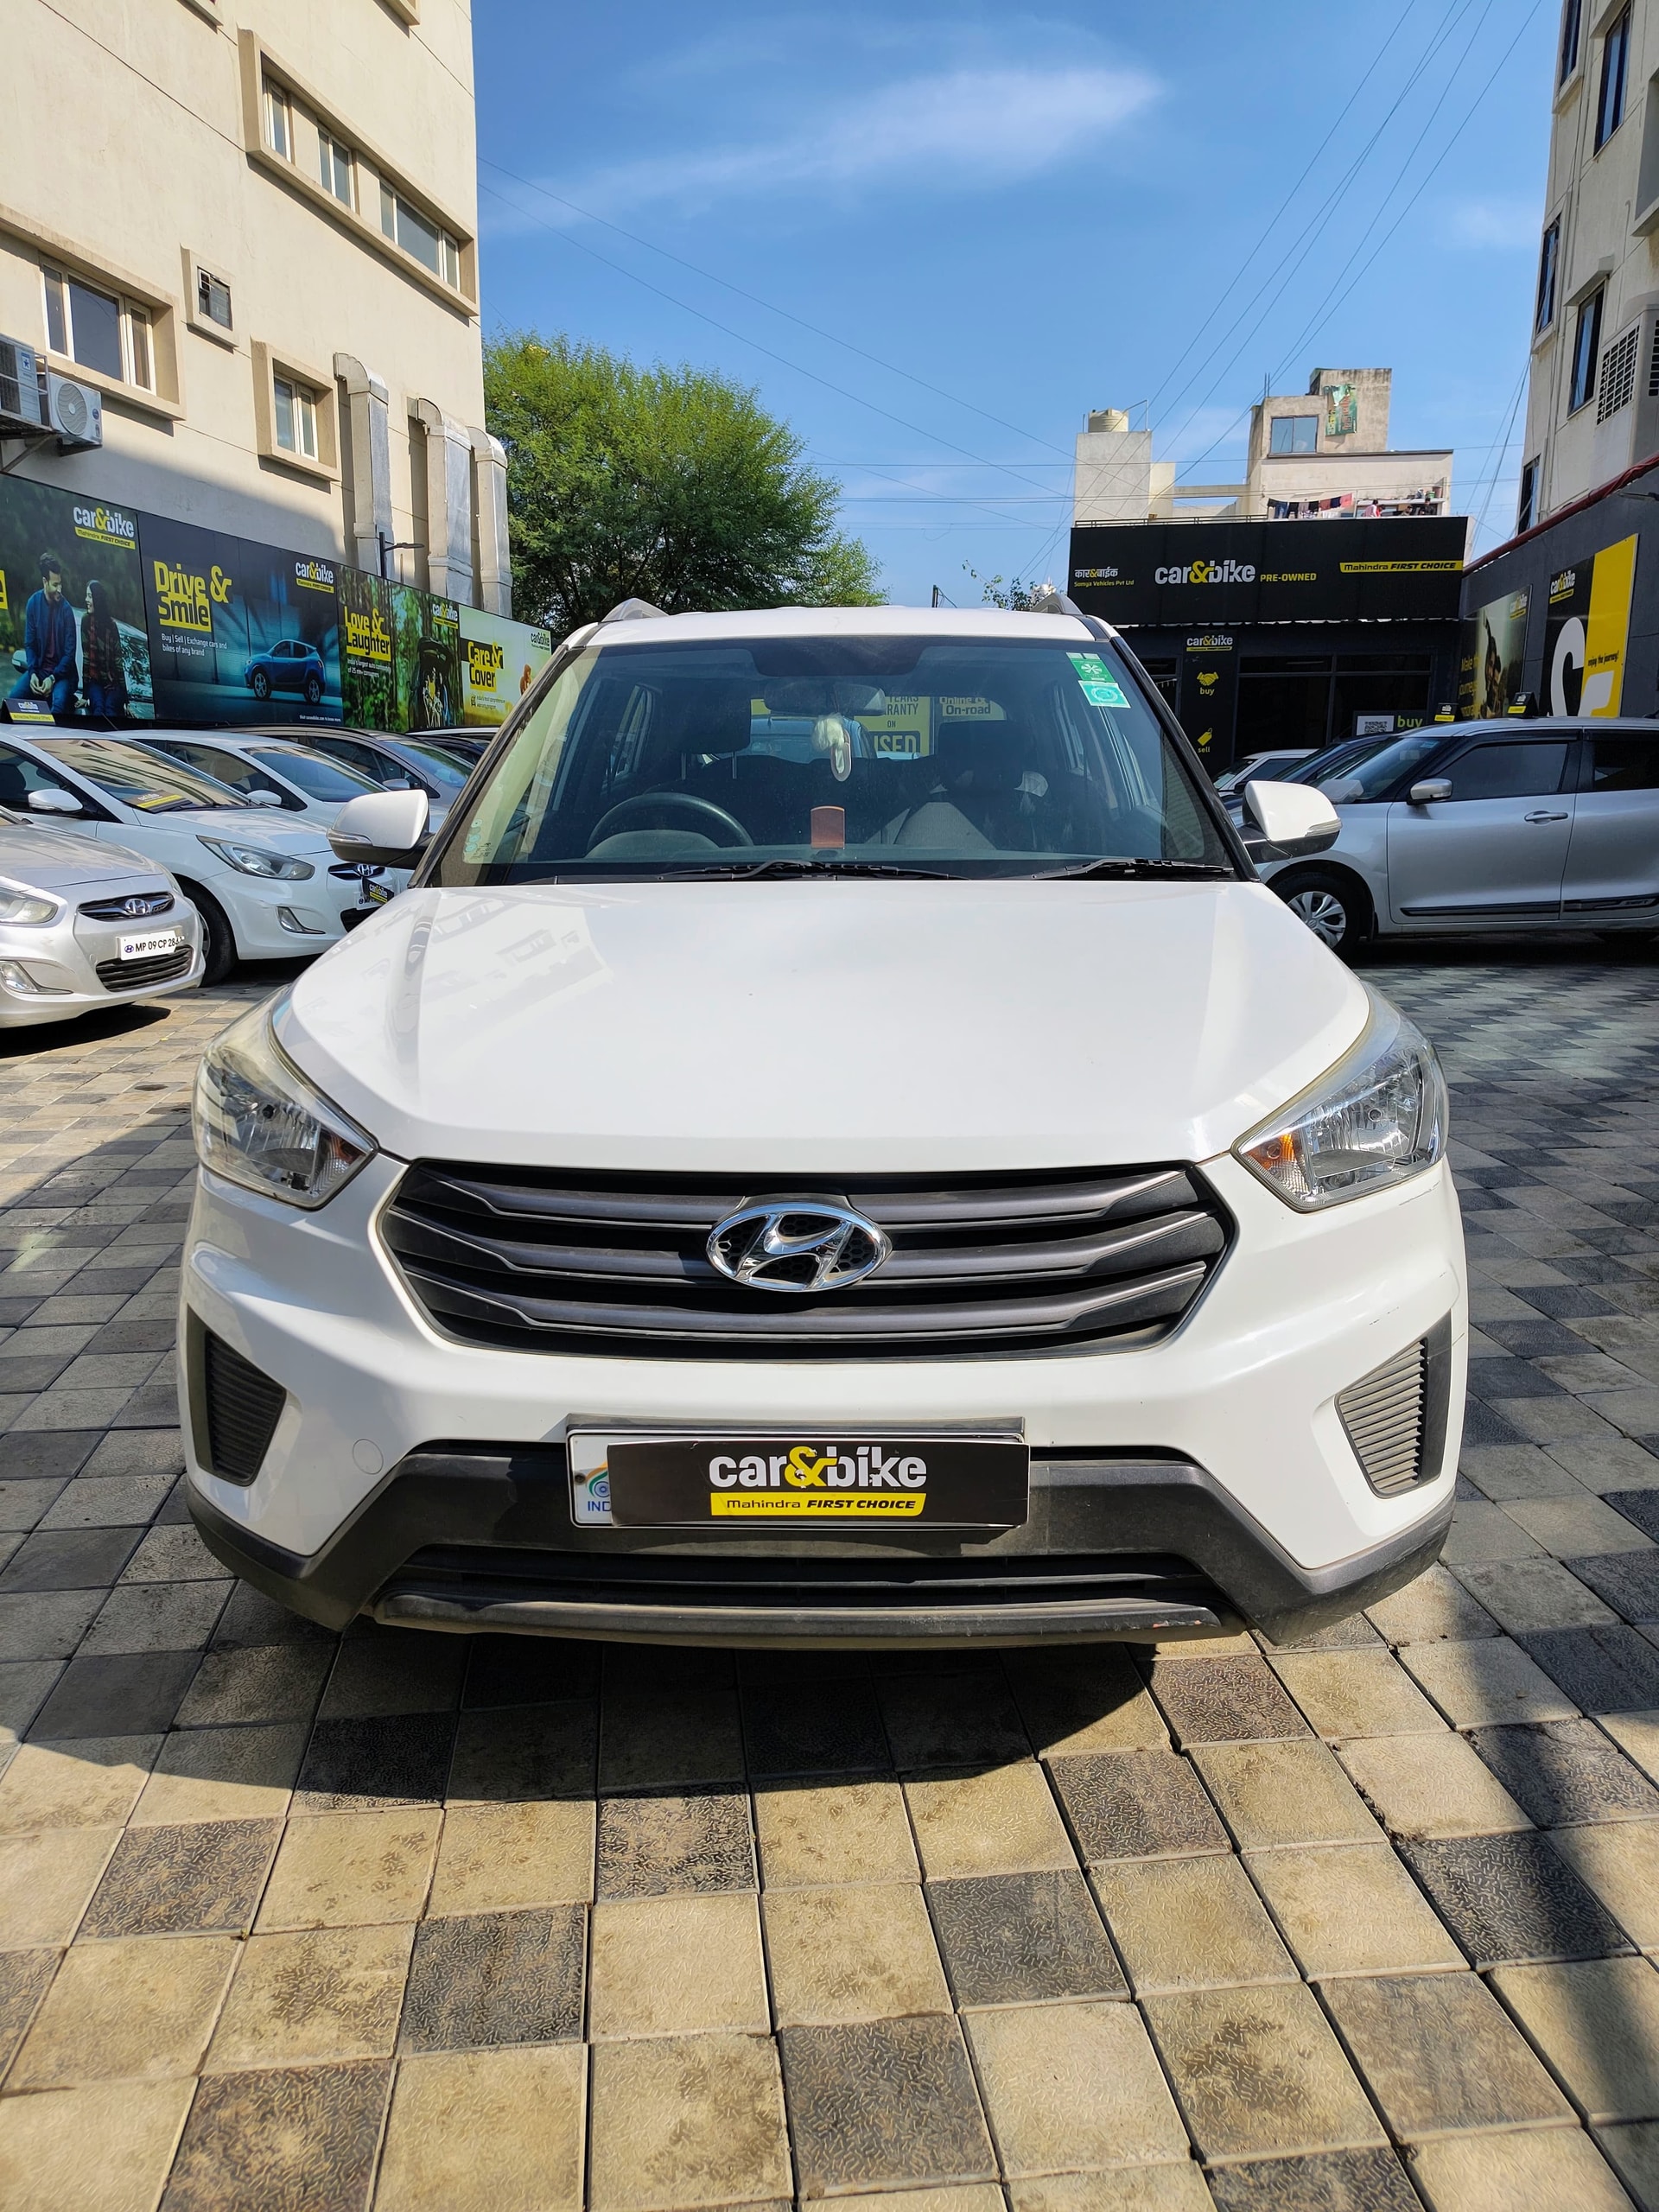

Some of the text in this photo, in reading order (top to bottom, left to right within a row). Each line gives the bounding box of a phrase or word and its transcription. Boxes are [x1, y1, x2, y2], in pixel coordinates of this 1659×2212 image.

[73, 506, 135, 537] car&bike
[154, 561, 232, 604] Drive &
[296, 562, 334, 584] car&bike
[1155, 560, 1317, 584] car&bike PRE-OWNED
[1551, 570, 1576, 594] car&bike
[158, 591, 210, 626] Smile
[344, 606, 385, 635] Love &
[346, 624, 390, 655] Laughter
[1186, 635, 1233, 646] car&bike
[467, 641, 503, 669] Care &
[469, 663, 495, 687] Cover
[1199, 687, 1215, 696] buy
[884, 703, 919, 715] RANTY
[946, 703, 990, 715] On-road
[1397, 715, 1423, 728] buy
[135, 942, 147, 952] MP
[148, 939, 157, 950] 09
[157, 938, 168, 949] CP
[709, 1446, 927, 1488] car&bike
[727, 1499, 917, 1510] Mahindra FIRST CHOICE
